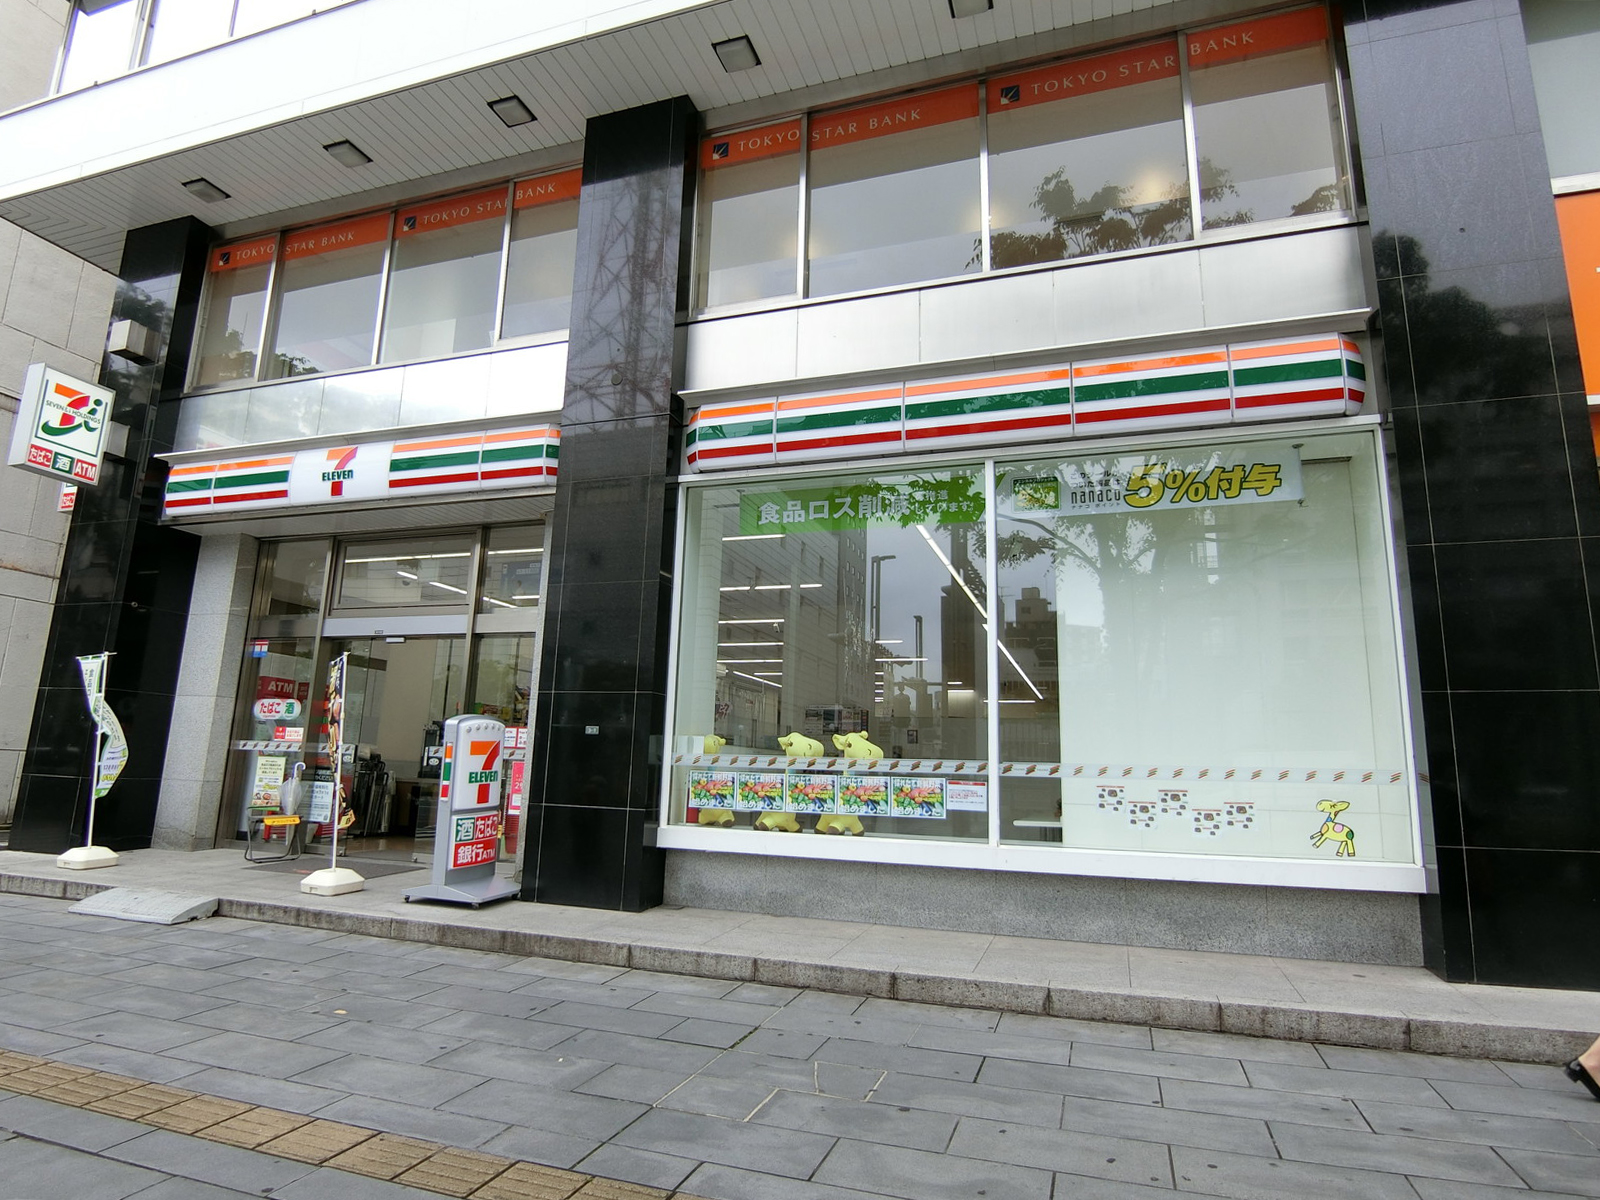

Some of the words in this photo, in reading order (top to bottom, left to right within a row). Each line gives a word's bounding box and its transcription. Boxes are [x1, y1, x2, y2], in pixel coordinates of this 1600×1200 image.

[1031, 69, 1107, 95] TOKYO
[1119, 55, 1176, 78] STAR
[1190, 31, 1254, 56] BANK
[738, 129, 800, 152] TOKYO
[811, 122, 857, 142] STAR
[869, 108, 921, 130] BANK
[423, 206, 470, 225] TOKYO
[516, 182, 556, 200] BANK
[236, 243, 276, 260] TOKYO
[285, 239, 315, 255] STAR
[321, 231, 355, 247] BANK
[71, 408, 101, 425] HOLDINGS
[29, 447, 52, 466] たばこ
[55, 455, 72, 472] 酒
[74, 461, 97, 480] ATM
[758, 494, 911, 525] 食品ロス削減
[268, 680, 294, 693] ATM
[260, 702, 281, 714] たばこ
[456, 819, 474, 841] 酒
[475, 815, 498, 837] たばこ
